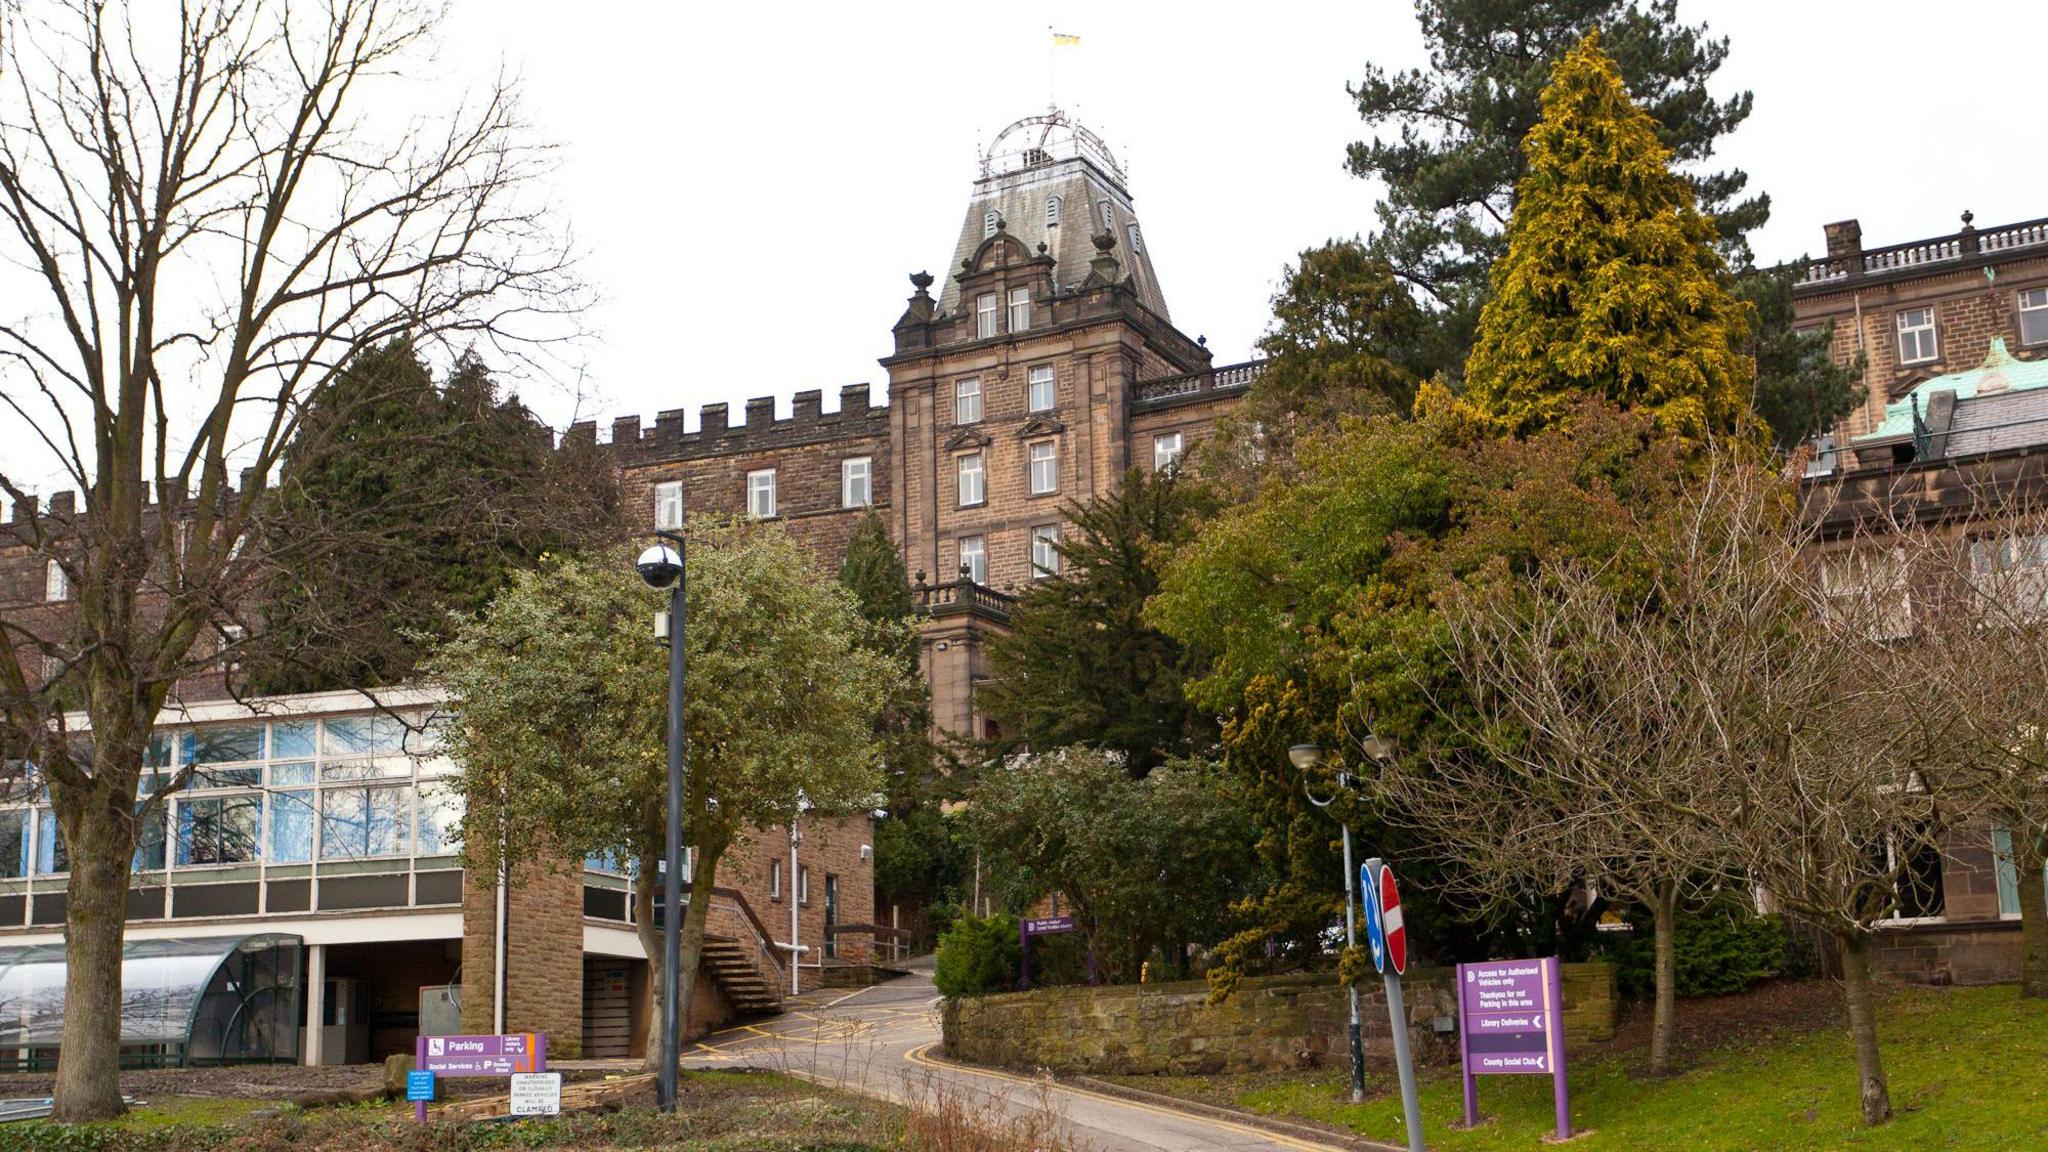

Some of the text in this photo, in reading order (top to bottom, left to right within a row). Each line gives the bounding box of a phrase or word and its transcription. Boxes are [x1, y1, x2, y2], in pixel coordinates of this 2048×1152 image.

[1508, 967, 1538, 976] Authorised
[1502, 978, 1515, 986] only
[1480, 1000, 1500, 1009] Parking
[1481, 1018, 1528, 1028] Library Deliveries
[449, 1041, 484, 1052] Parking
[484, 1061, 492, 1069] P
[1483, 1058, 1503, 1067] County
[1522, 1057, 1536, 1065] Club
